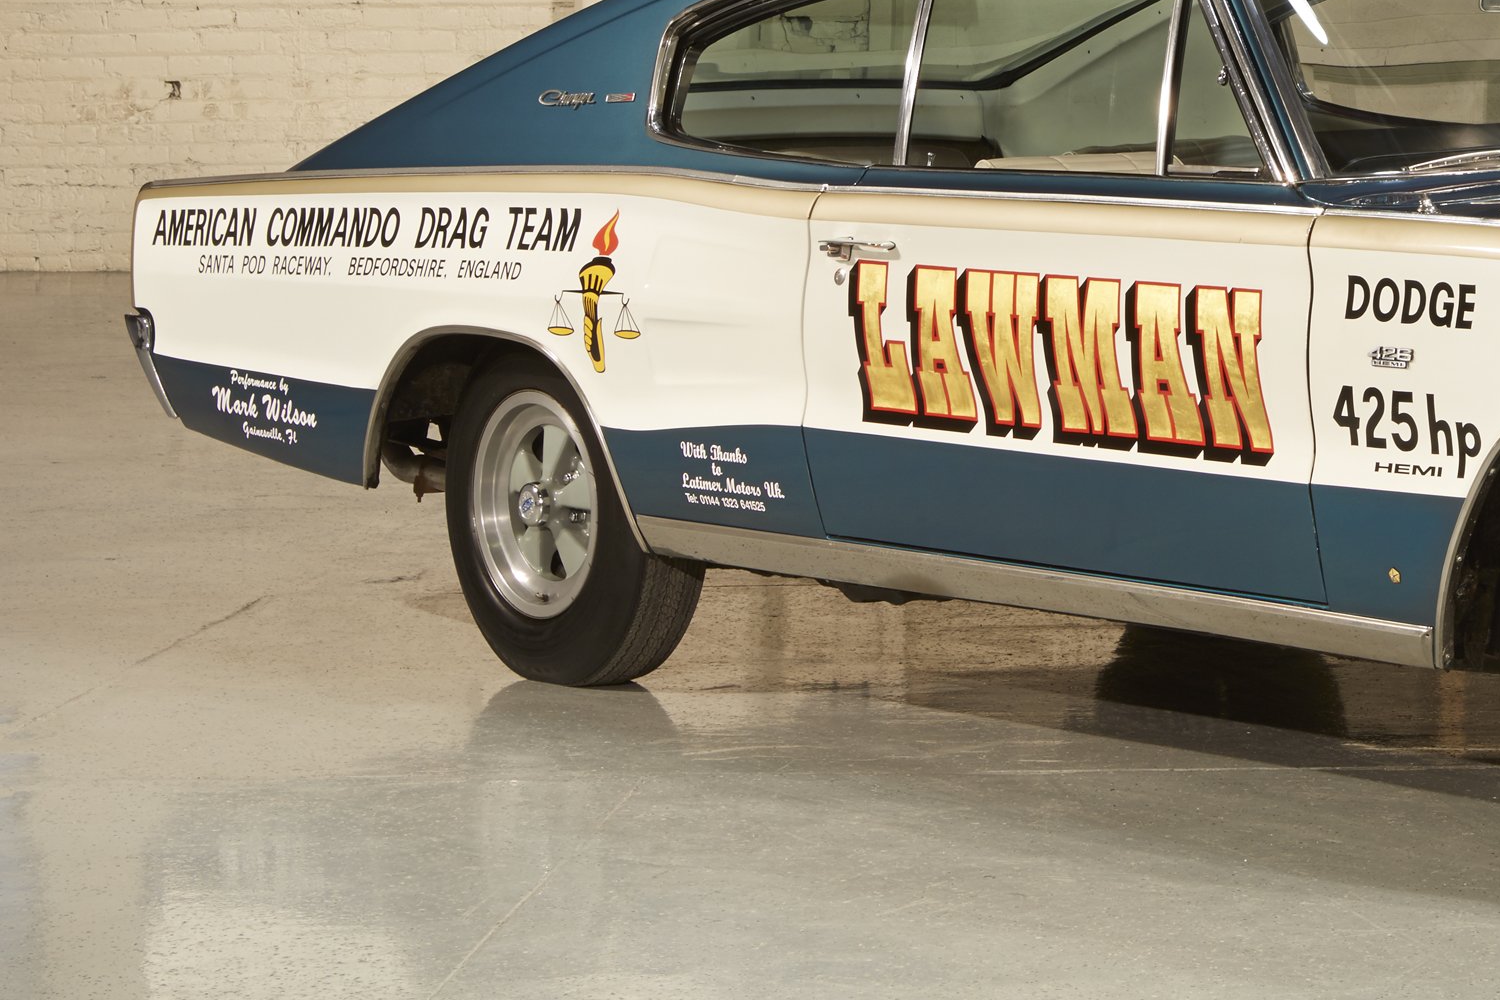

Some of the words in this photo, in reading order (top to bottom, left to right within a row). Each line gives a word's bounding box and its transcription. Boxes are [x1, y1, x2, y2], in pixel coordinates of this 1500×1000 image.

[152, 207, 257, 247] AMERICAN
[266, 207, 401, 248] COMMANDO
[414, 206, 490, 249] DRAG
[505, 206, 582, 252] TEAM
[198, 254, 234, 274] SANTA
[241, 255, 266, 275] POD
[457, 259, 522, 281] ENGLAND
[1344, 274, 1477, 330] DODGE
[848, 259, 1274, 467] LAWMAN
[230, 369, 277, 390] Performance
[279, 377, 290, 395] by
[211, 385, 258, 419] Mark
[262, 394, 317, 428] Wilson
[242, 420, 285, 443] Gainesville,
[680, 441, 707, 460] With
[710, 444, 748, 464] Thanks
[711, 462, 723, 476] to
[1374, 462, 1443, 478] HEMI
[682, 472, 723, 493] Latimer
[724, 477, 761, 497] Motors
[699, 494, 720, 507] 01144
[721, 496, 739, 509] 1323
